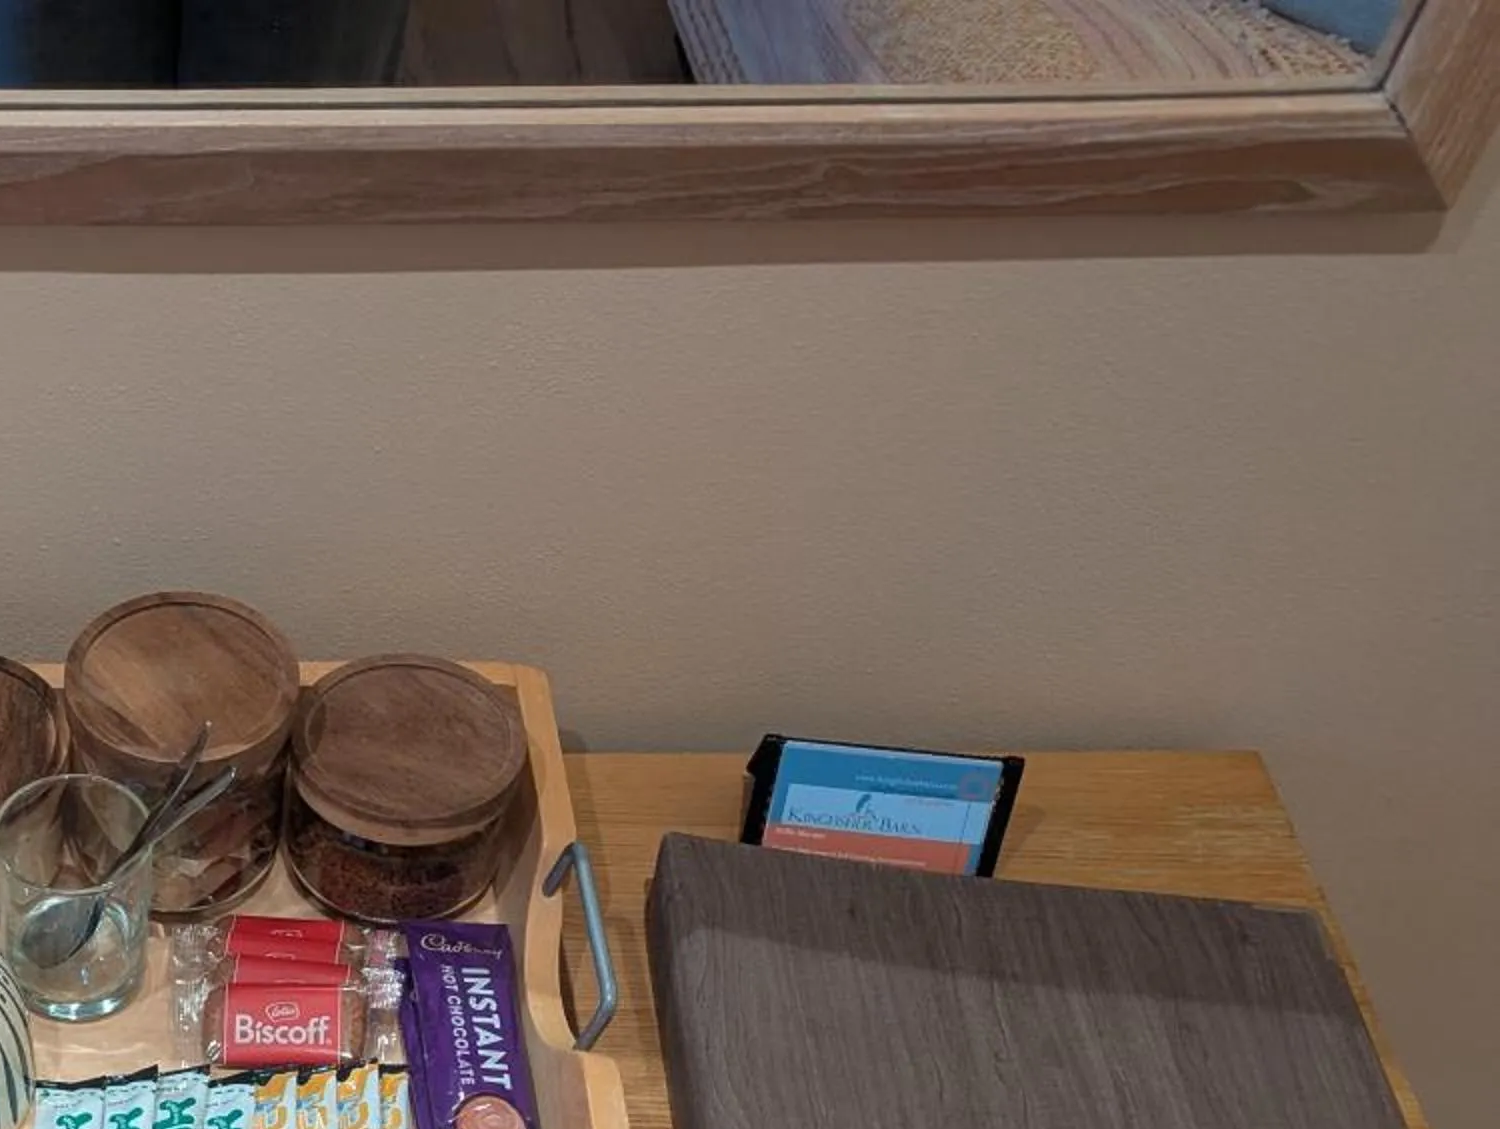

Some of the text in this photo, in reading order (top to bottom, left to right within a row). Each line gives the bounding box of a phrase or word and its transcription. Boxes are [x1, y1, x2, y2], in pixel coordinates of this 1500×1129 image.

[234, 1013, 329, 1046] Biscoff
[441, 964, 475, 1085] HOT CHOCOLATE
[461, 967, 512, 1090] INSTANT
